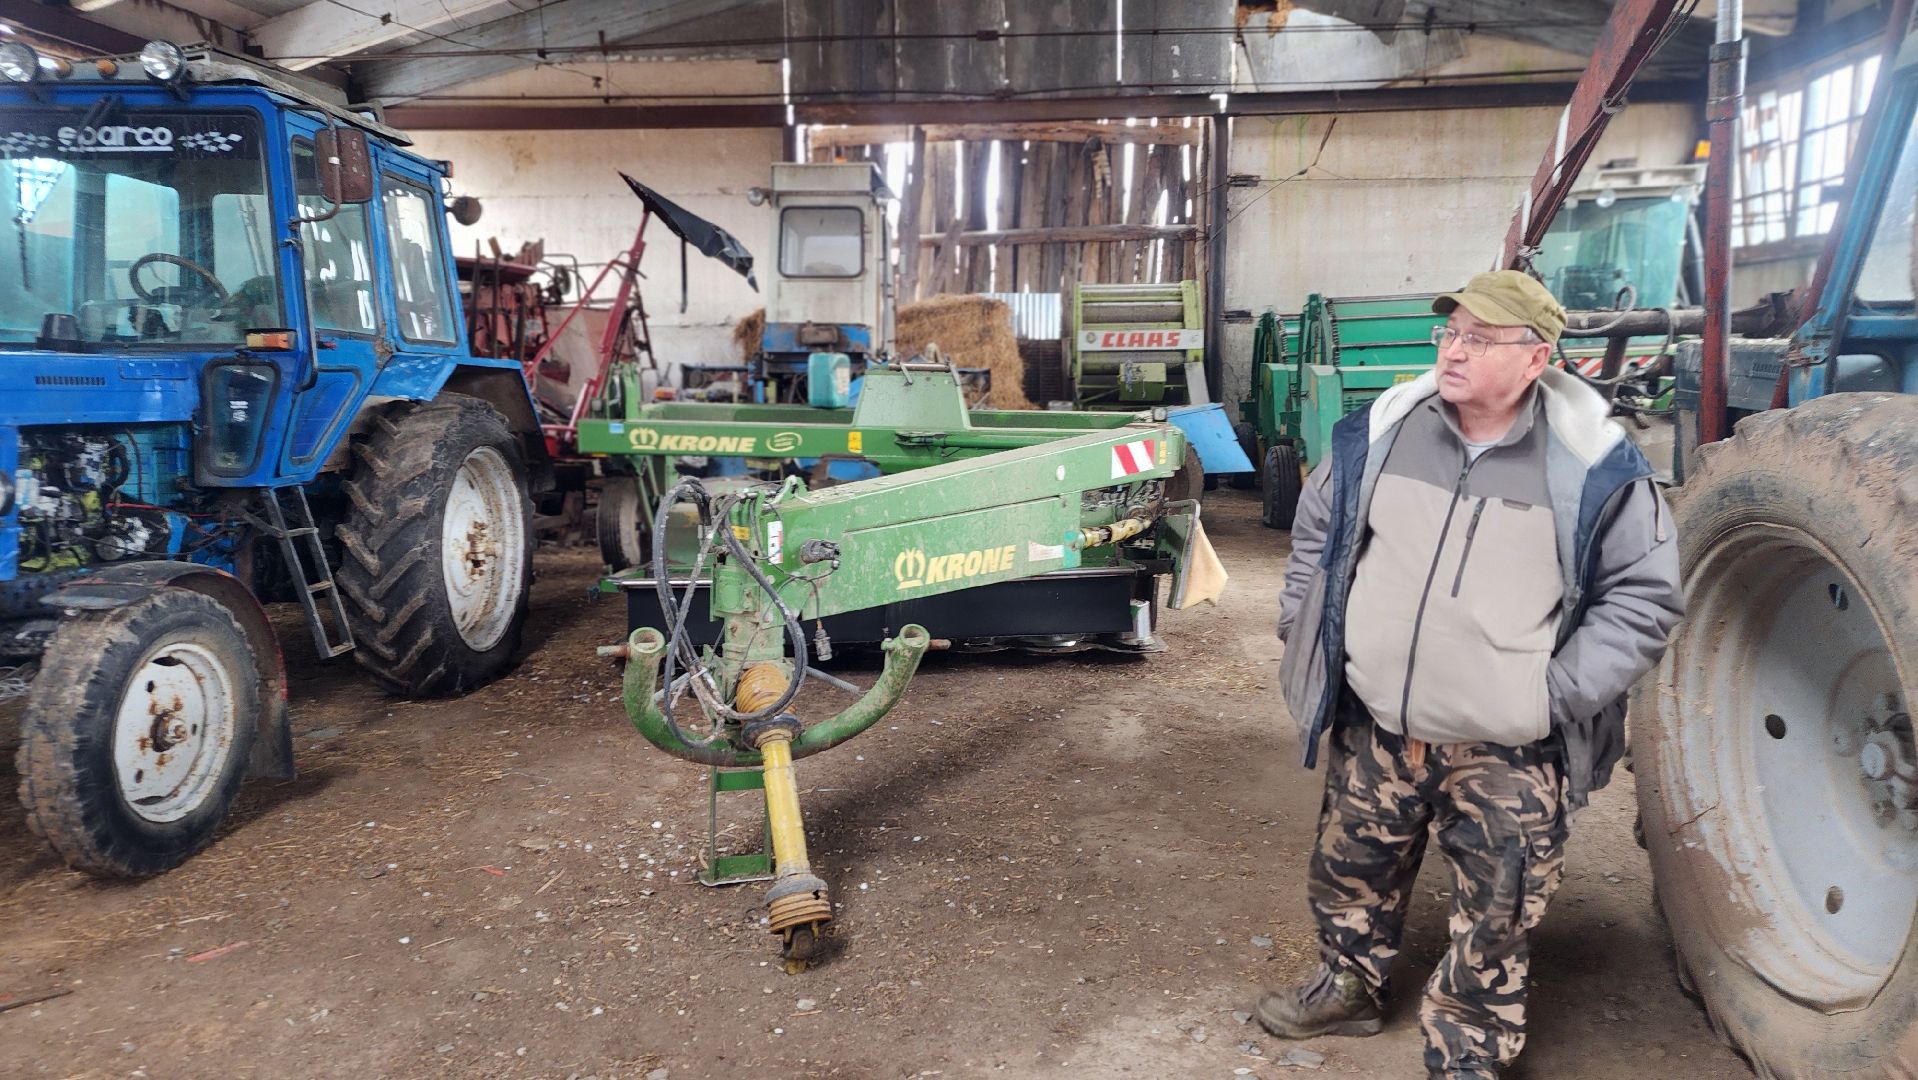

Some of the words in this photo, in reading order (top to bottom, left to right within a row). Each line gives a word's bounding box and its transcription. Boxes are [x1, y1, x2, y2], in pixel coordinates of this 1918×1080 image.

[57, 126, 173, 146] sparco
[1101, 332, 1181, 348] CLAAS
[660, 434, 757, 453] KRONE
[925, 544, 1017, 585] KRONE
